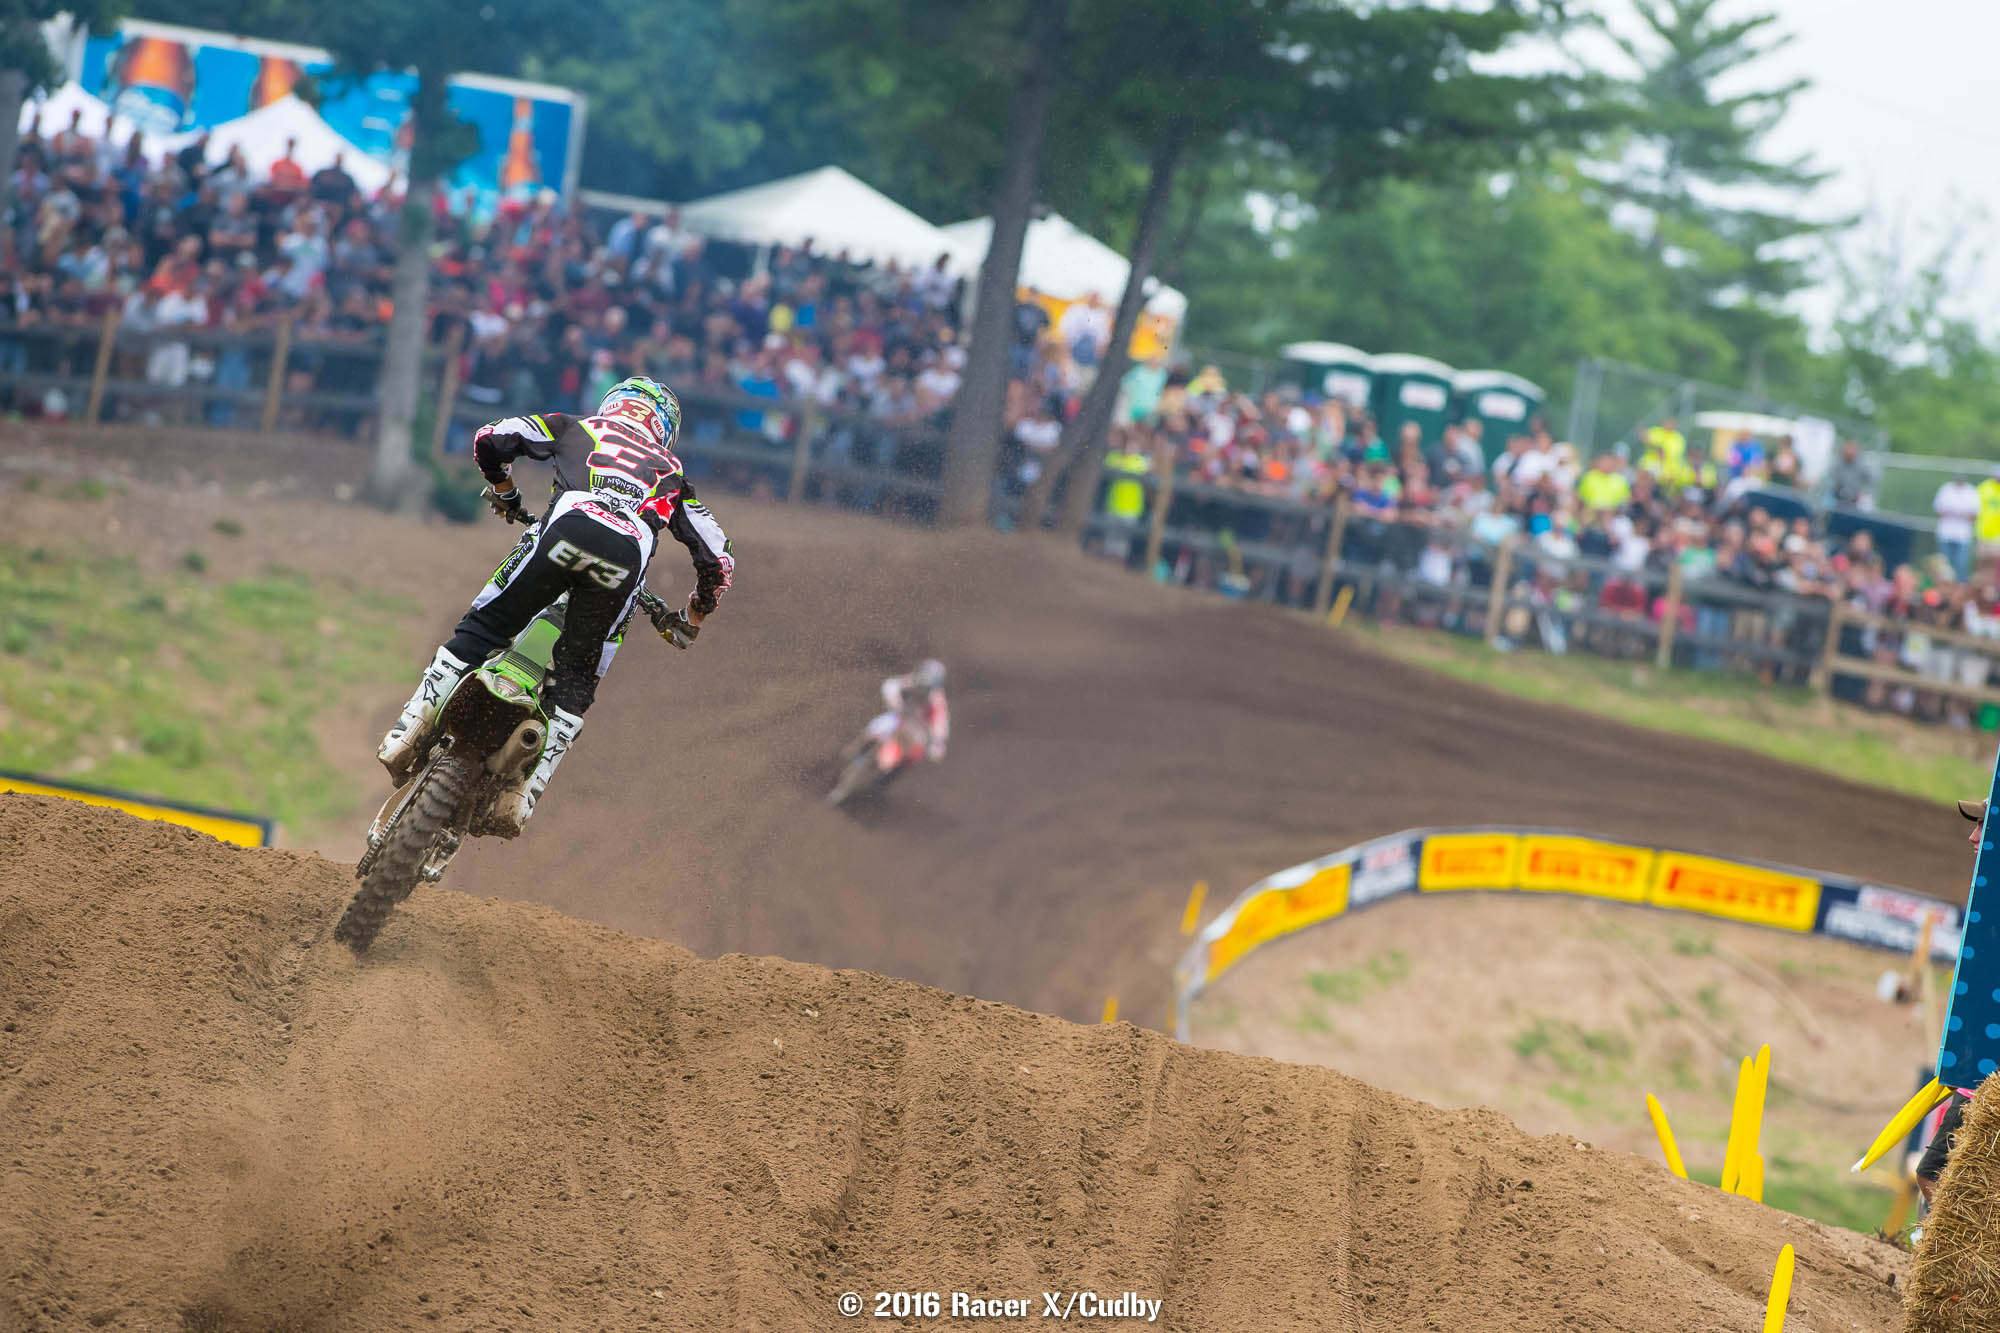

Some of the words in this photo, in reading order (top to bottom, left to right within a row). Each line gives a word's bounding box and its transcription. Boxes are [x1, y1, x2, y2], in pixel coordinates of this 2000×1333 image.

[605, 402, 620, 411] BELL
[621, 401, 652, 422] 3
[653, 419, 664, 436] BELL
[587, 434, 674, 488] 3
[502, 541, 533, 573] MONSTER
[547, 540, 630, 590] ET3
